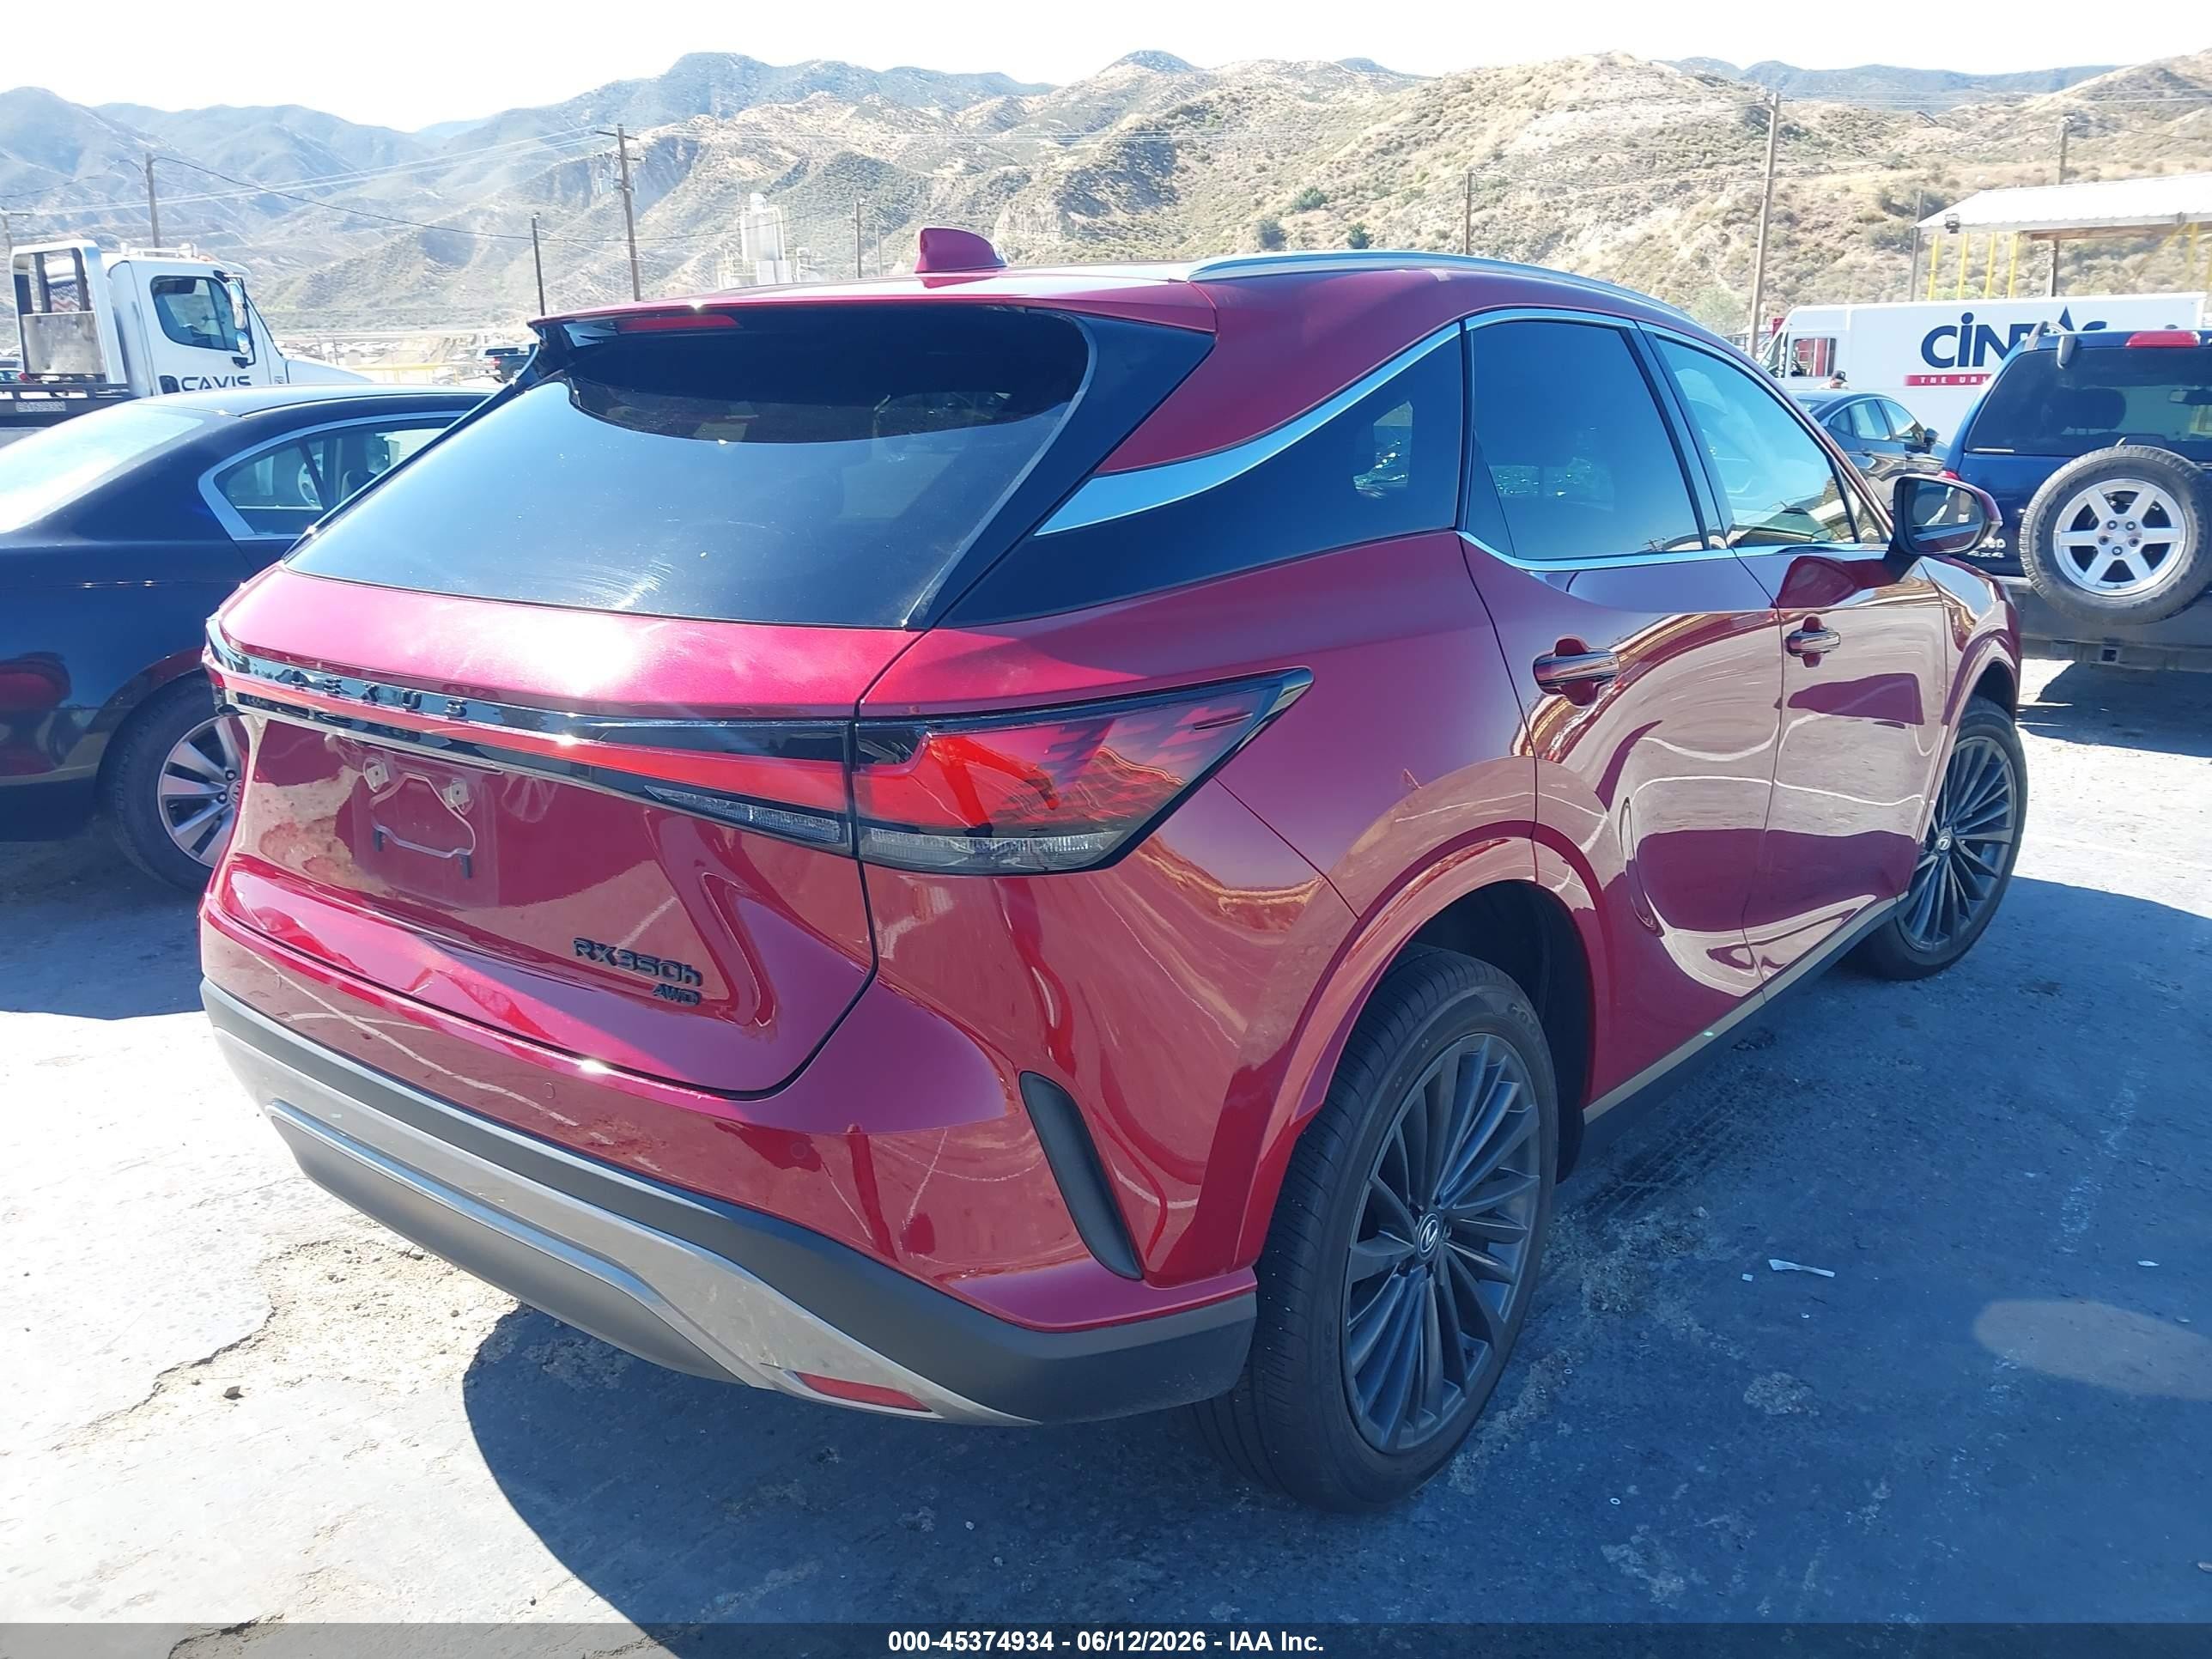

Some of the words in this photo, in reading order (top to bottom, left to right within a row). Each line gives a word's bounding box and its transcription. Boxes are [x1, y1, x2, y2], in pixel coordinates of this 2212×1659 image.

[180, 375, 252, 392] CAVIS
[573, 937, 703, 988] RX350h
[653, 982, 702, 1006] AWD
